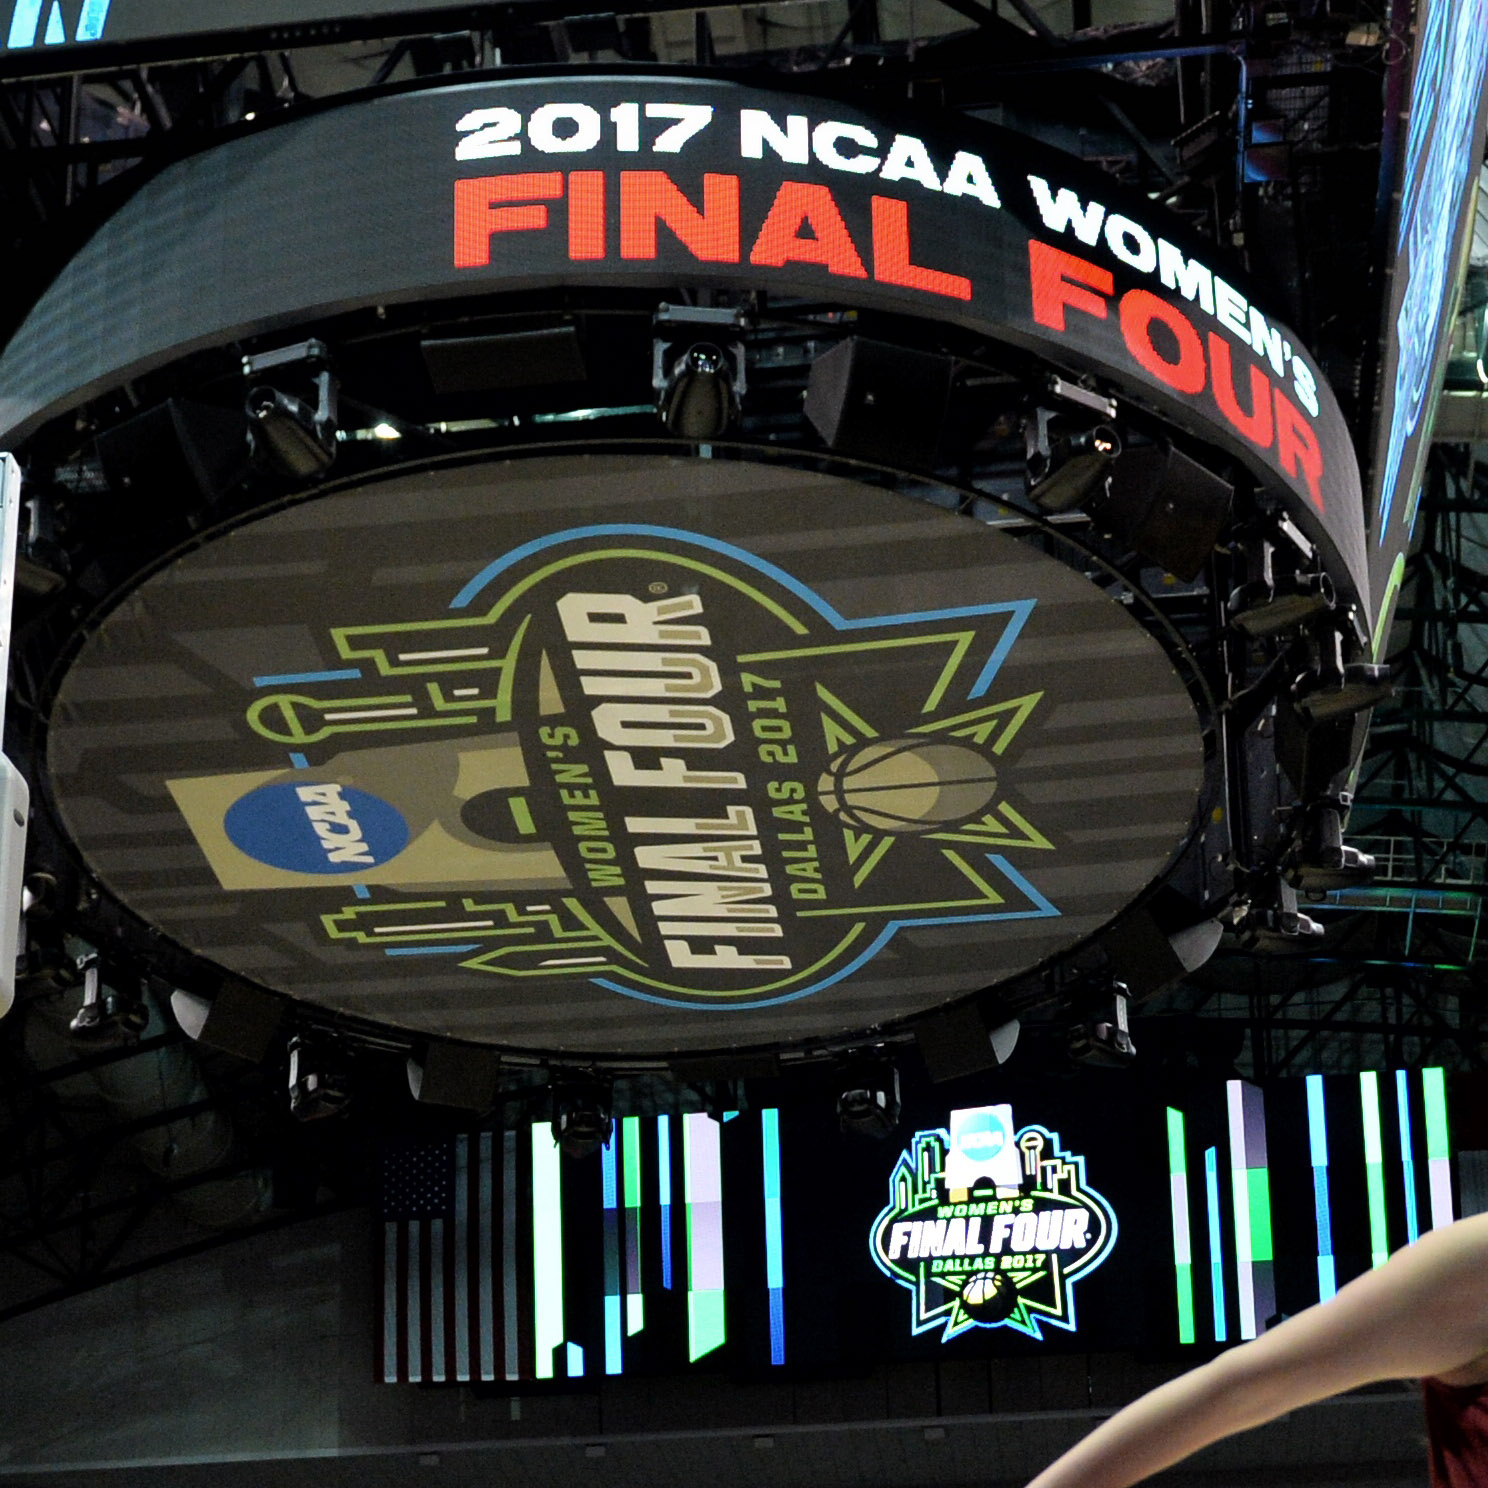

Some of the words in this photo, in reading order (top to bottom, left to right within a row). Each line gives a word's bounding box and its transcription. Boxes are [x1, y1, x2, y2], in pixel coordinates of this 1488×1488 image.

[454, 102, 712, 161] 2017
[741, 109, 1001, 207] NCAA
[1028, 173, 1320, 419] WOMEN'S
[454, 169, 971, 301] FINAL
[1028, 239, 1324, 512] FOUR
[556, 591, 748, 790] FOUR
[740, 671, 799, 764] 2017
[295, 783, 375, 864] NCAA
[541, 724, 626, 888] WOMEN'S
[767, 779, 827, 901] DALLAS
[624, 804, 793, 970] FINAL
[887, 1216, 985, 1260] FINAL
[988, 1207, 1091, 1255] FOUR
[930, 1256, 995, 1273] DALLAS
[999, 1253, 1047, 1270] 2017
[937, 1197, 1035, 1219] WOMEN'S
